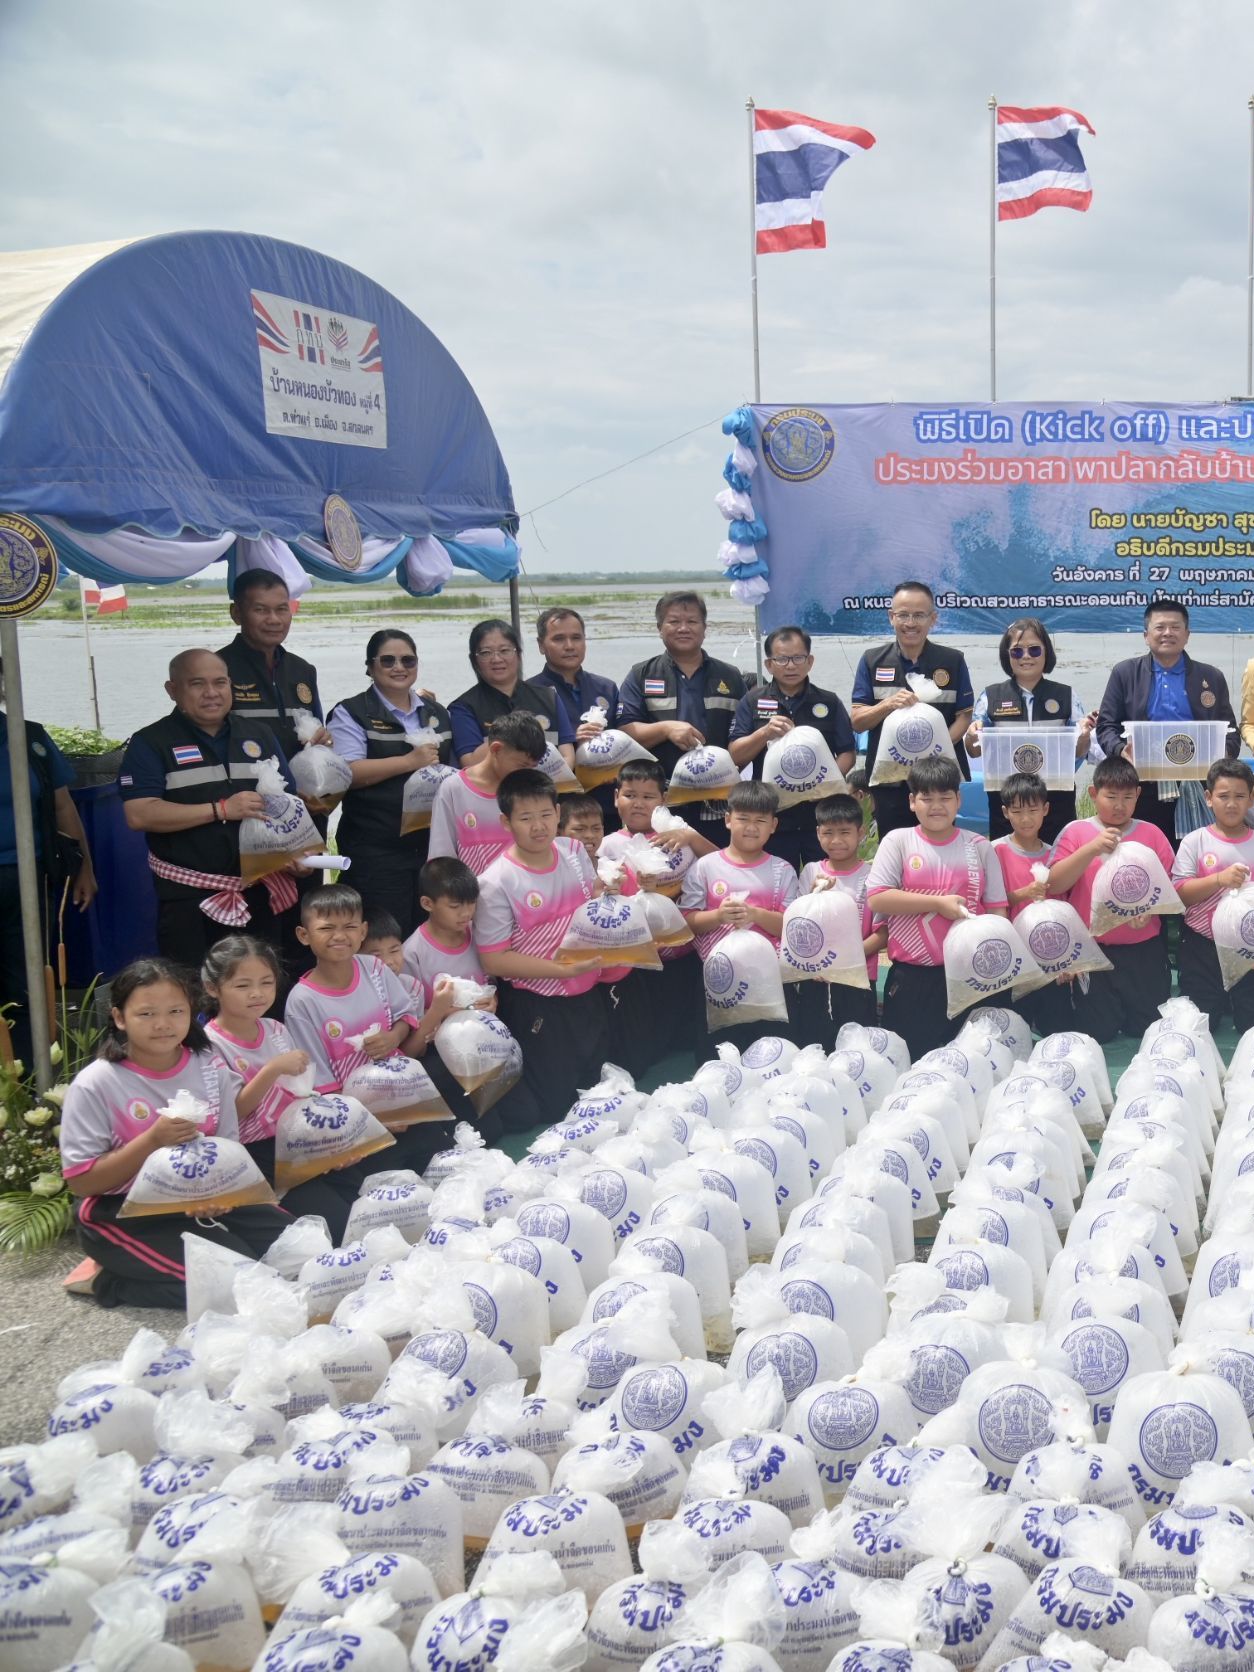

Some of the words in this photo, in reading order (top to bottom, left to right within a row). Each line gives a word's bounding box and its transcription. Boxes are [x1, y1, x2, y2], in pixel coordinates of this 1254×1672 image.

[270, 367, 357, 407] บ้านหนองบัวทอง
[374, 394, 383, 411] 4
[917, 410, 1010, 443] พิธีเปิด
[1022, 413, 1101, 444] (Kick
[1110, 413, 1168, 444] off)
[877, 452, 1067, 483] ประมงร่วมอาสา
[1090, 508, 1127, 529] โดย
[1132, 508, 1228, 531] นายบัญชา
[1052, 566, 1125, 583] วันอังคาร
[1128, 561, 1141, 581] ที่
[1149, 566, 1169, 582] 27
[844, 597, 860, 610] ณ
[773, 766, 829, 793] กรมประมง
[964, 840, 981, 916] THARAEWITTAY
[1104, 886, 1162, 918] กรมประมง
[783, 947, 837, 973] กรมประมง
[964, 957, 1023, 994] กรมประมง
[48, 1400, 114, 1437] ประมง
[336, 1476, 430, 1516] มประมง
[1021, 1505, 1062, 1560] กรมป
[1148, 1509, 1204, 1556] กรมป
[944, 1582, 994, 1647] ประมง
[1037, 1566, 1134, 1632] กรมประมง
